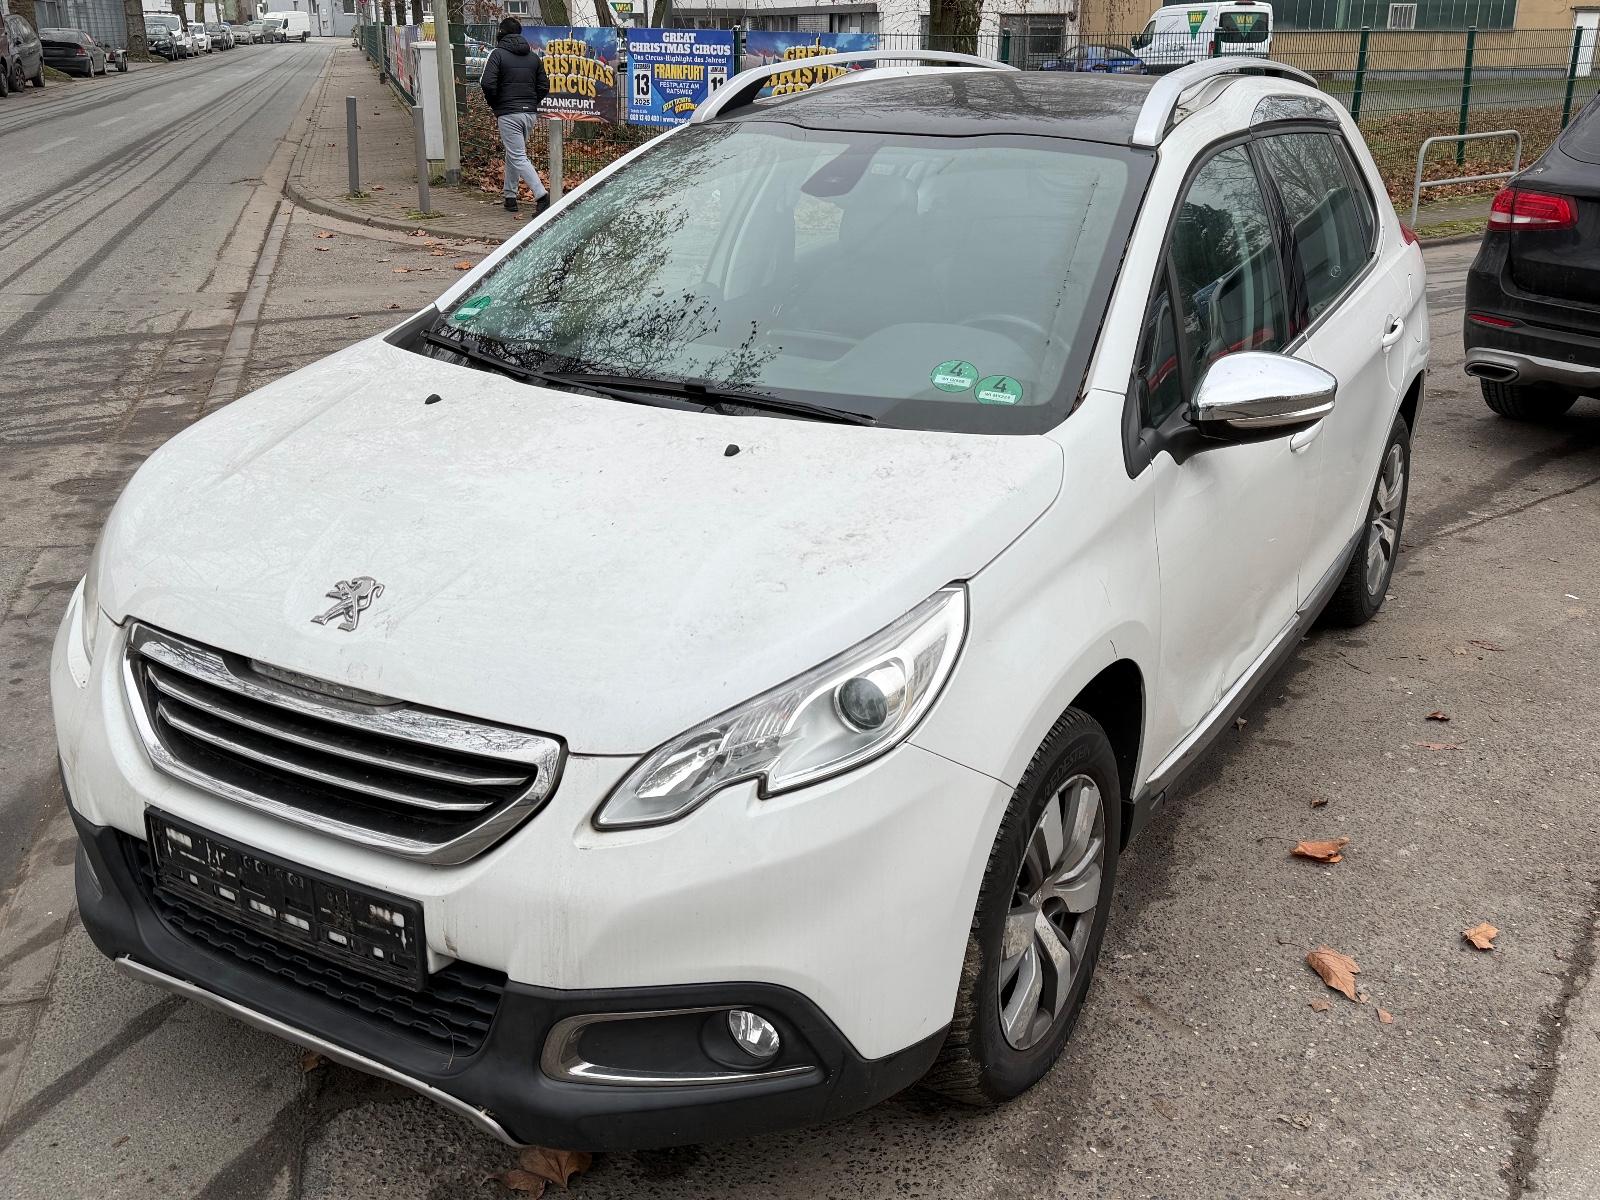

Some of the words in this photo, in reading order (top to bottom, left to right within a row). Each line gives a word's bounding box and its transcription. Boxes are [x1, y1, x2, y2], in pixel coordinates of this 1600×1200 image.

[1191, 12, 1203, 23] WM
[1236, 15, 1254, 24] WM
[662, 32, 697, 43] GREAT
[545, 39, 587, 56] GREAT
[629, 42, 691, 54] CHRISTMAS
[692, 44, 731, 56] CIRCUS
[645, 54, 693, 63] Circus-Highlight
[543, 54, 614, 87] RISTMAS
[654, 64, 704, 80] FRANKFURT
[549, 72, 597, 97] IRCUS
[635, 73, 650, 96] 13
[660, 81, 690, 89] FESTPLATZ
[666, 87, 693, 95] RATSWEG
[541, 97, 596, 109] FRANKFURT
[634, 98, 651, 106] 2025
[950, 362, 963, 377] 4
[992, 376, 1007, 393] 4
